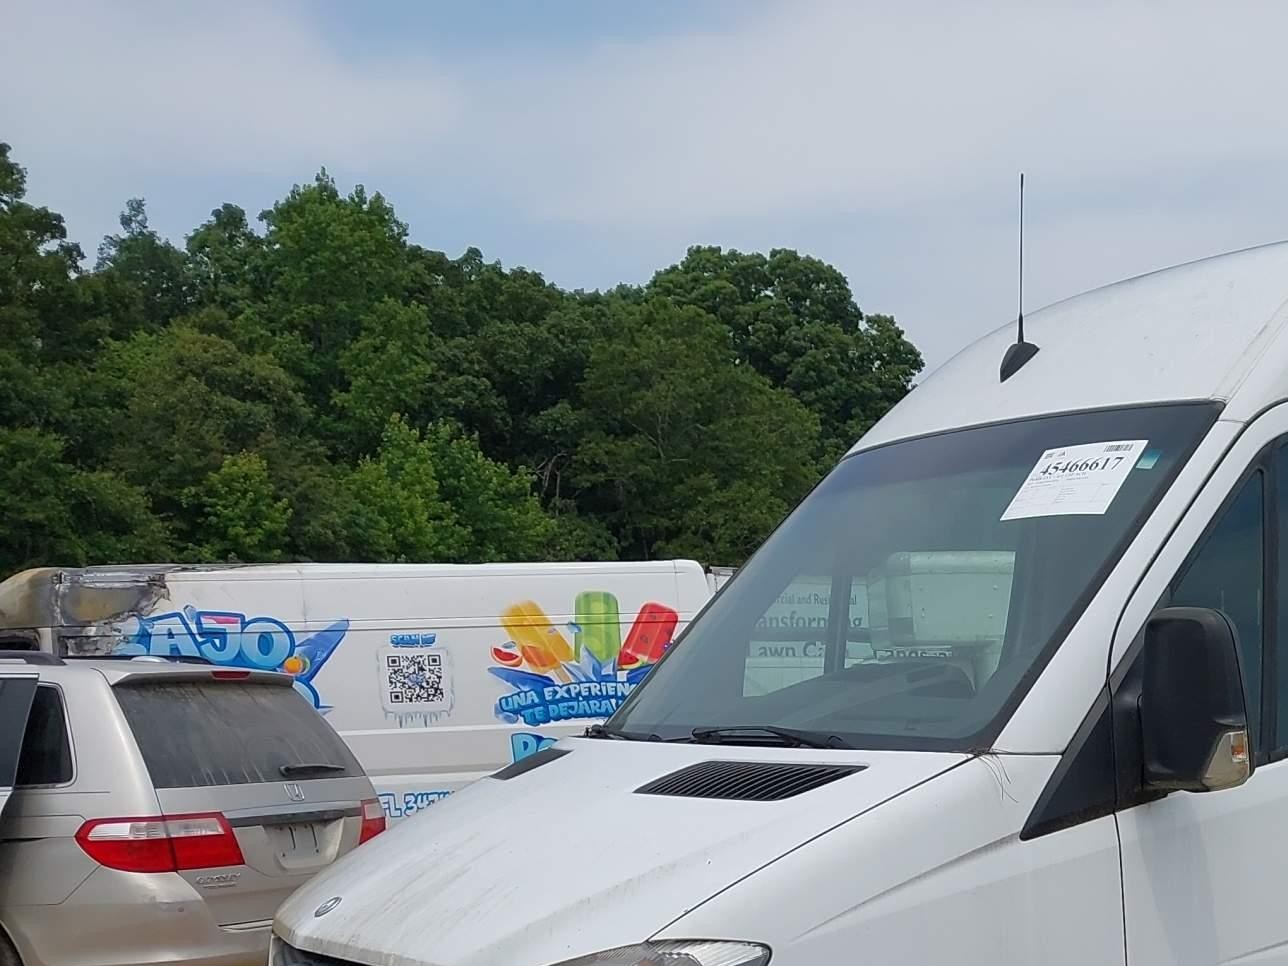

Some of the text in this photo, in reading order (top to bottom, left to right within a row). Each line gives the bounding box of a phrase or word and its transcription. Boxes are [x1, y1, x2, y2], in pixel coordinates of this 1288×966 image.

[1040, 456, 1124, 477] 45466617
[500, 681, 638, 711] UNA EXPERIEN
[520, 705, 546, 722] TE
